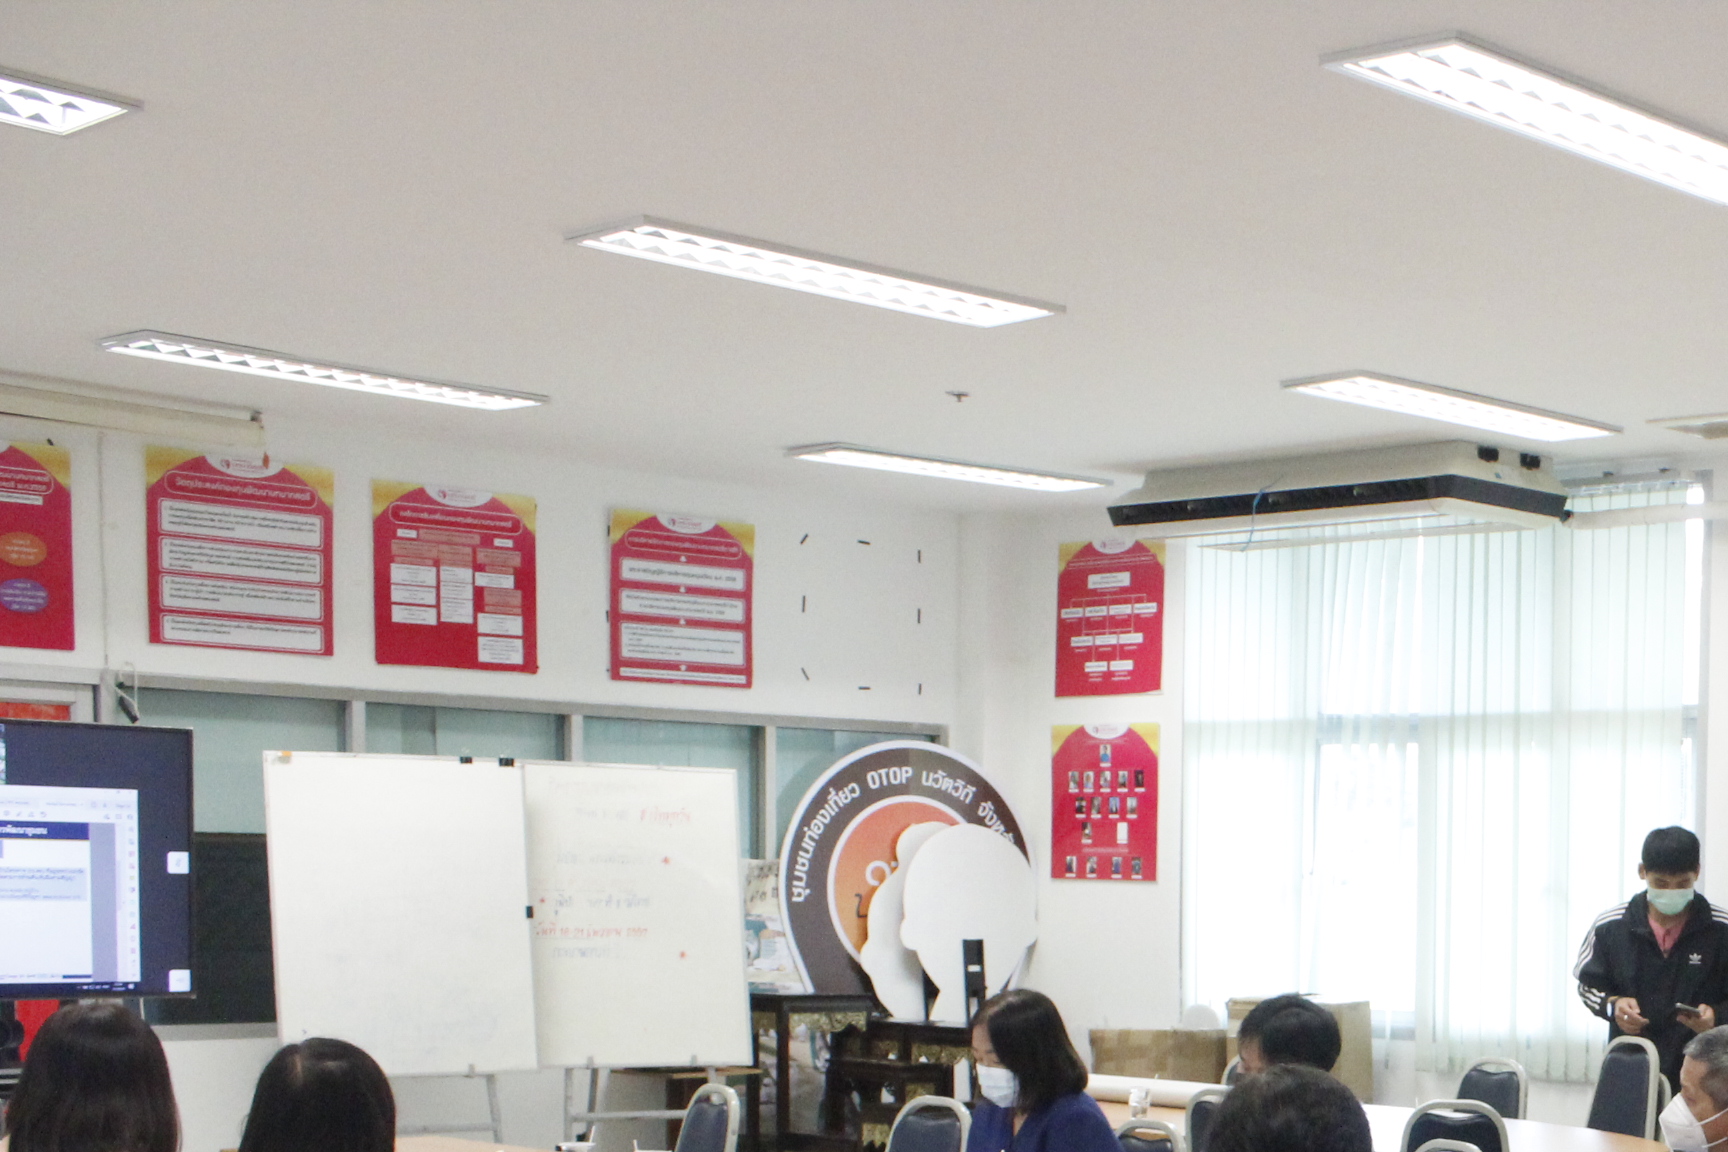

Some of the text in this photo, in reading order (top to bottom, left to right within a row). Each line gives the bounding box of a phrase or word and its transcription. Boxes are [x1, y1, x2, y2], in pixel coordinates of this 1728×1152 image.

[792, 782, 861, 903] ชุมชนท่องเที่ยว
[866, 766, 914, 790] OTOP
[921, 769, 978, 805] นวัตวิถี
